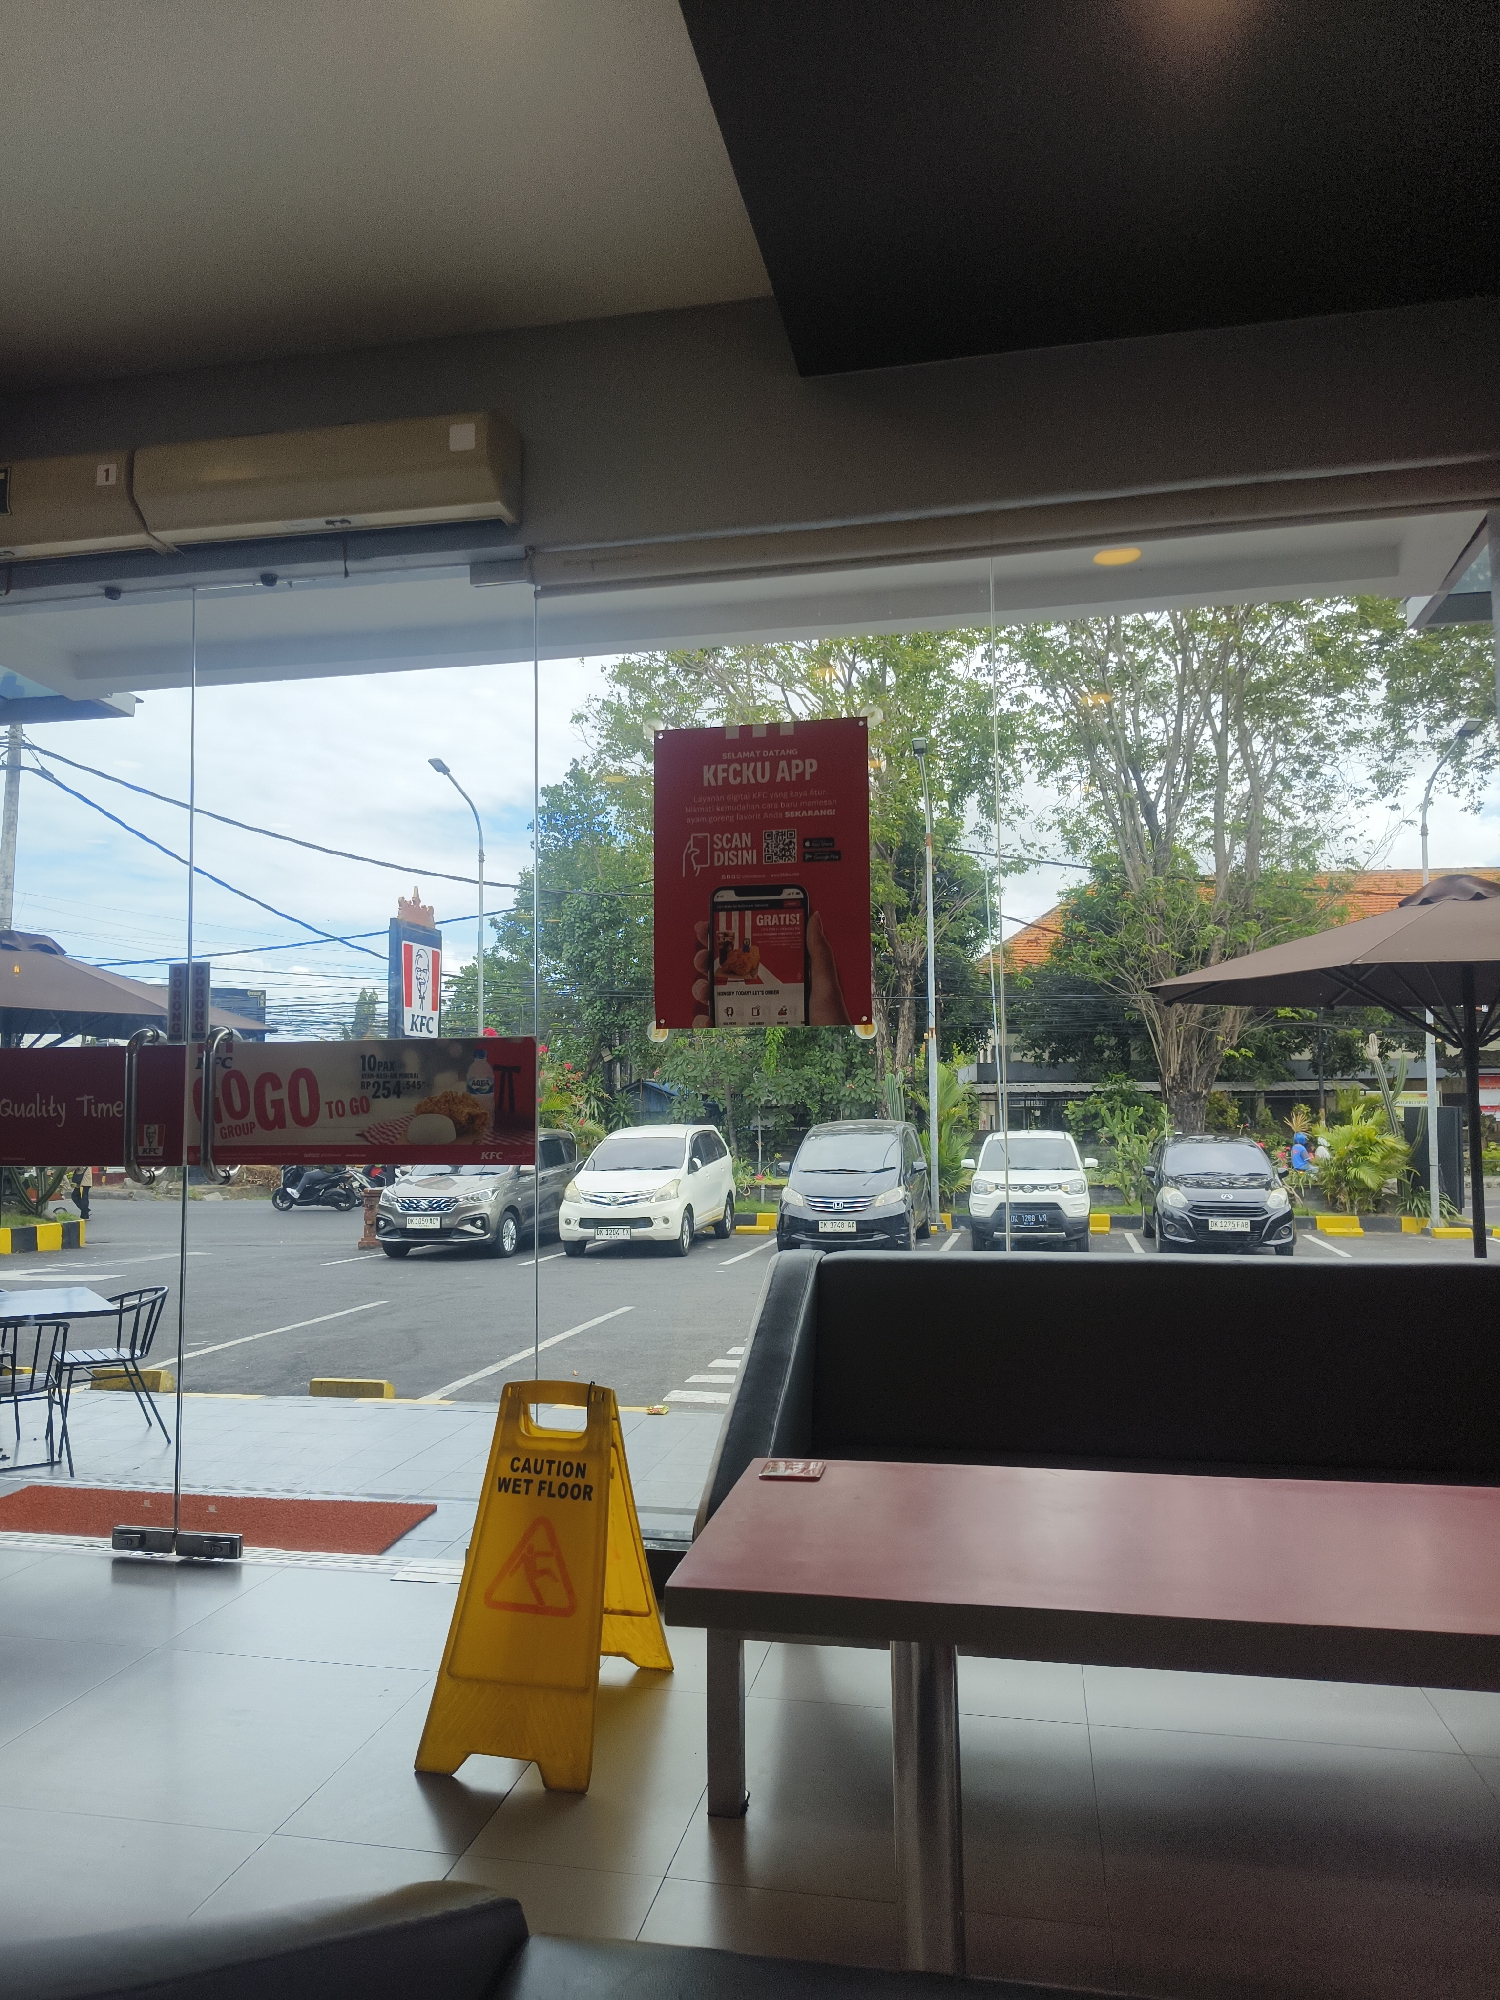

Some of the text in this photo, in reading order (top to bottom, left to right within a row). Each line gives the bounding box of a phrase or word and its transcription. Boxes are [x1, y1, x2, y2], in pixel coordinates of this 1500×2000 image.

[103, 467, 110, 482] 1
[722, 749, 798, 760] SELAMAT DATANG
[702, 758, 818, 787] KFCKU APP
[693, 795, 725, 804] Layanan
[726, 792, 751, 803] digital
[752, 791, 768, 800] KFC
[769, 790, 788, 800] yang
[761, 801, 778, 809] cara
[780, 799, 798, 808] baru
[686, 815, 707, 825] ayam
[763, 809, 783, 819] Anda
[784, 808, 836, 819] SEKARANG!
[713, 831, 752, 850] SCAN
[714, 849, 757, 867] DISINI
[756, 913, 800, 926] GRATIS!
[410, 1013, 434, 1034] KFC
[471, 1079, 490, 1087] AQUA
[0, 1092, 124, 1128] Quality Time
[325, 1095, 371, 1119] TO GO
[220, 1121, 256, 1140] GROUP
[142, 1147, 159, 1155] KFC
[480, 1151, 503, 1160] KFC
[1210, 1220, 1219, 1228] DK
[510, 1456, 587, 1479] CAUTION
[497, 1477, 593, 1501] WET FLOOR
